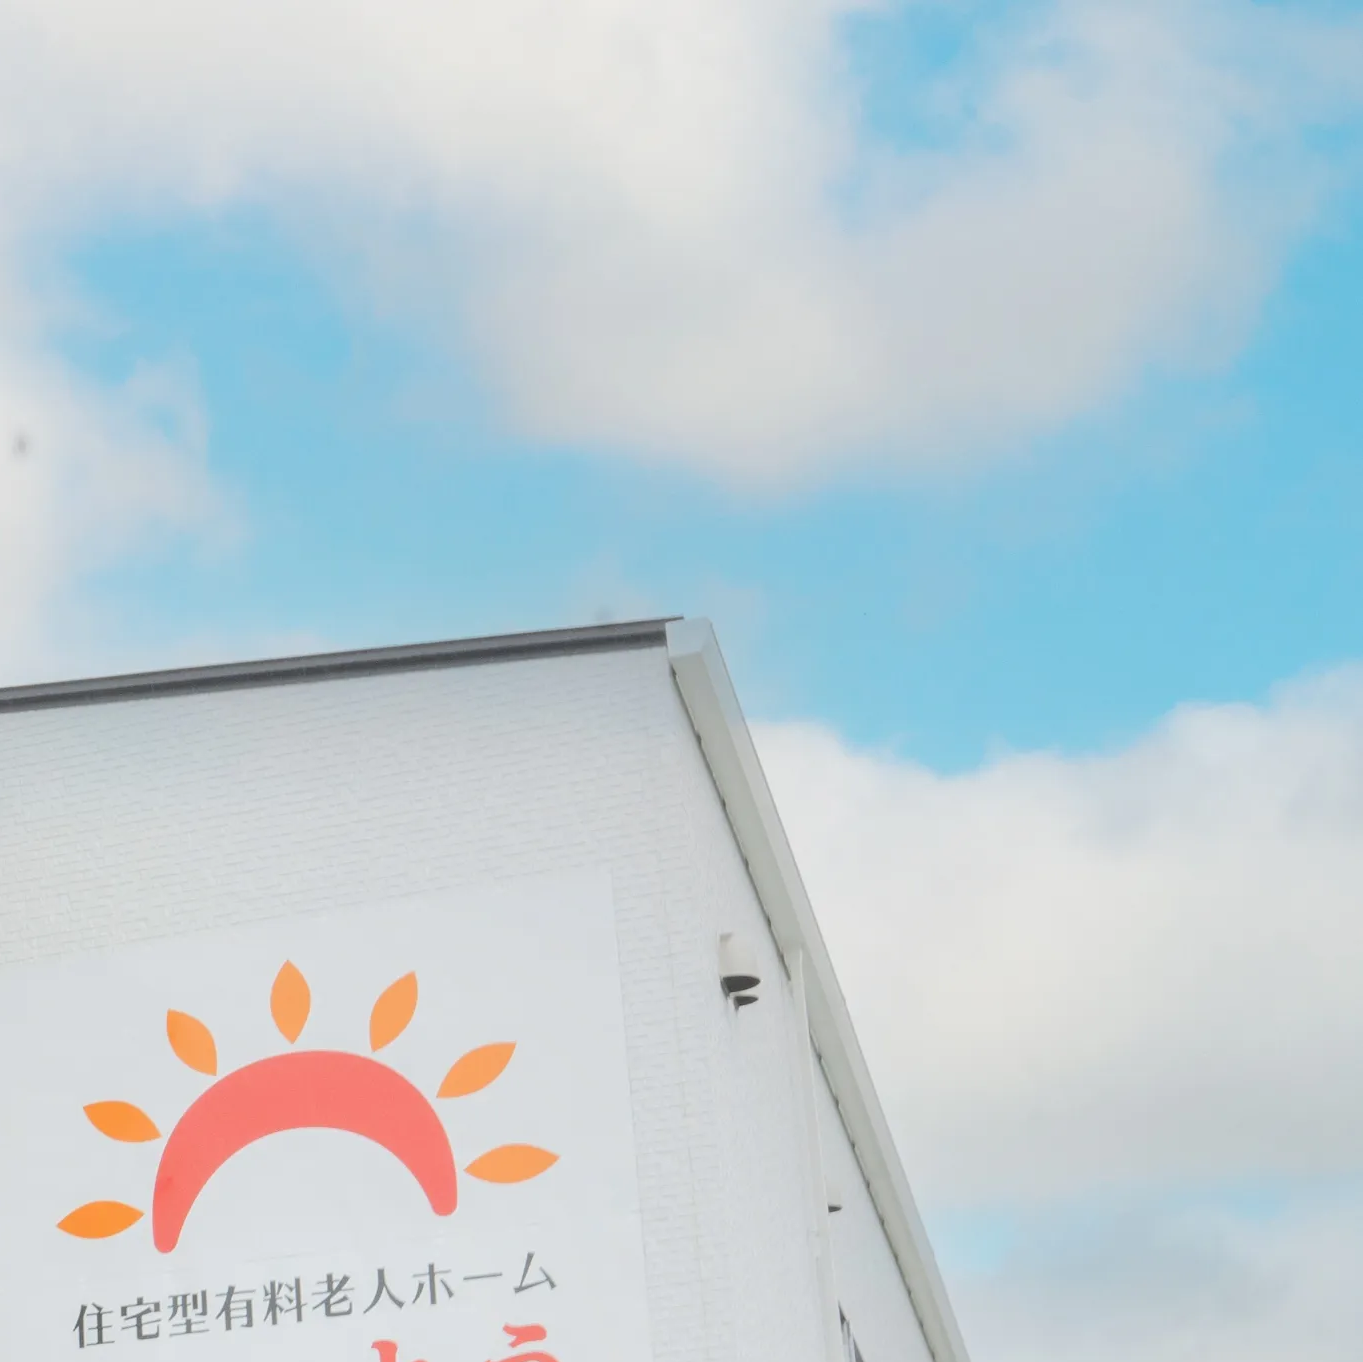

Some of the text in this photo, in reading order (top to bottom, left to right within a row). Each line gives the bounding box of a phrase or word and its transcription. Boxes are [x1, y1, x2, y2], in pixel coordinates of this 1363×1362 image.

[72, 1251, 558, 1348] 住宅型有料老人ホーム
